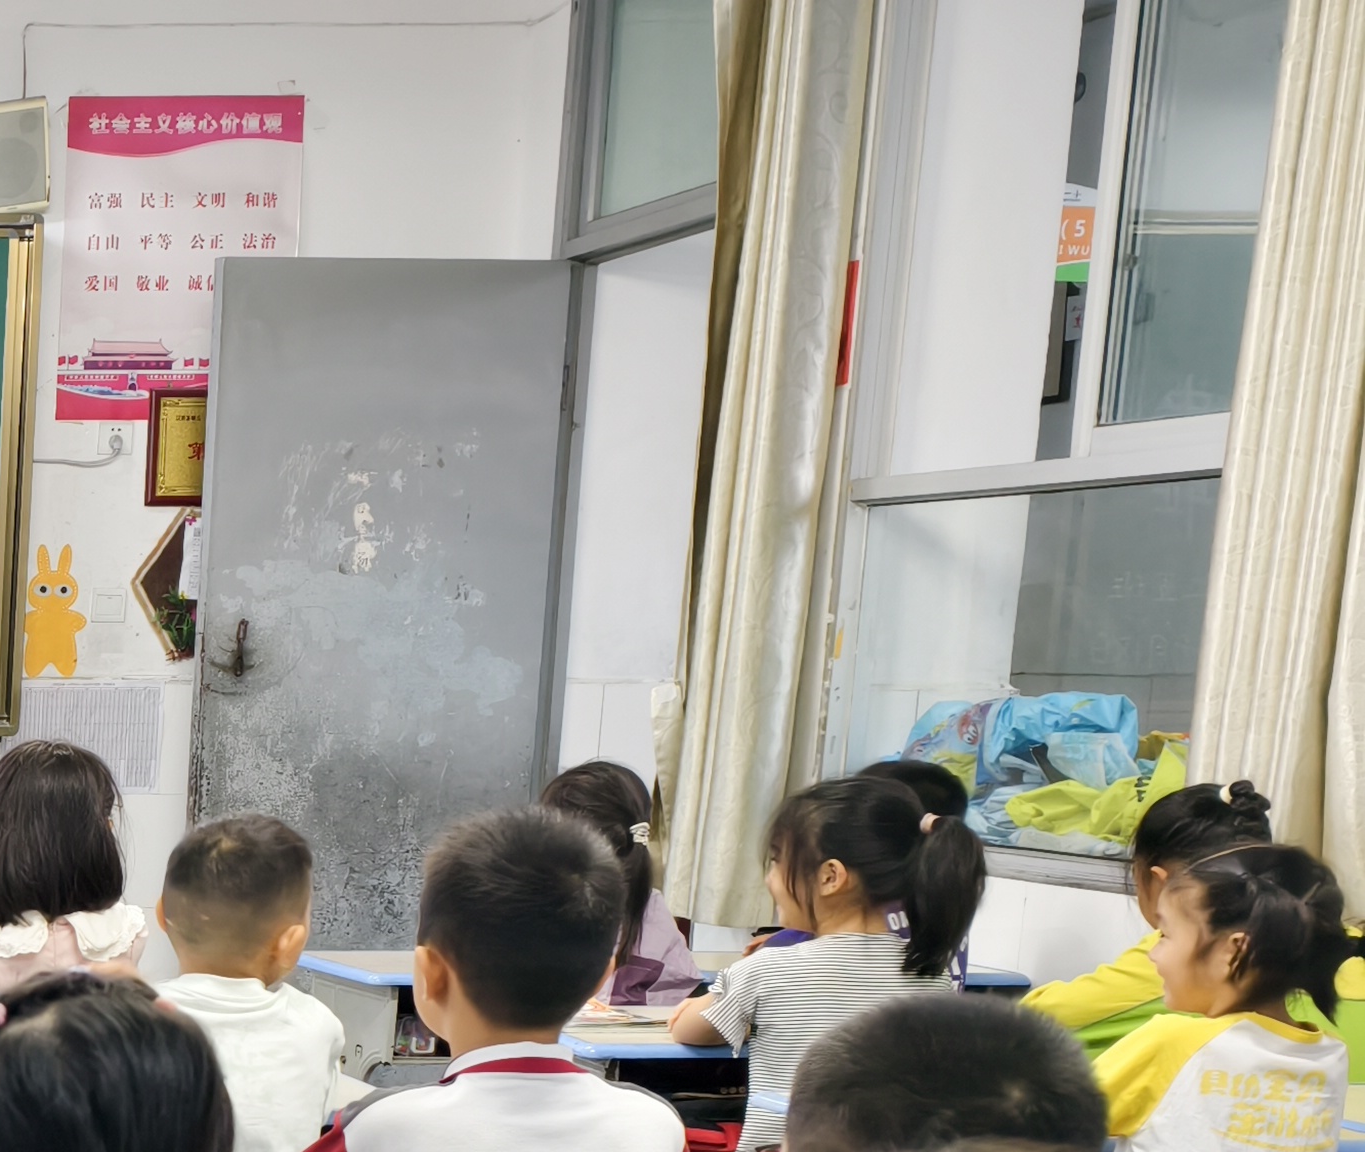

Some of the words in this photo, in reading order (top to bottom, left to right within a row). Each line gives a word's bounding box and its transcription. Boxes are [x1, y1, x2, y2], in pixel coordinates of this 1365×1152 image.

[88, 113, 282, 134] 社会主义核心价值观
[88, 192, 122, 209] 富强
[140, 192, 173, 209] 民主
[193, 192, 226, 209] 文明
[244, 192, 278, 209] 和谐
[87, 234, 120, 250] 自由
[140, 233, 173, 250] 平等
[190, 234, 224, 250] 公正
[242, 233, 276, 250] 法治
[84, 274, 119, 292] 爱国
[136, 274, 169, 292] 敬业
